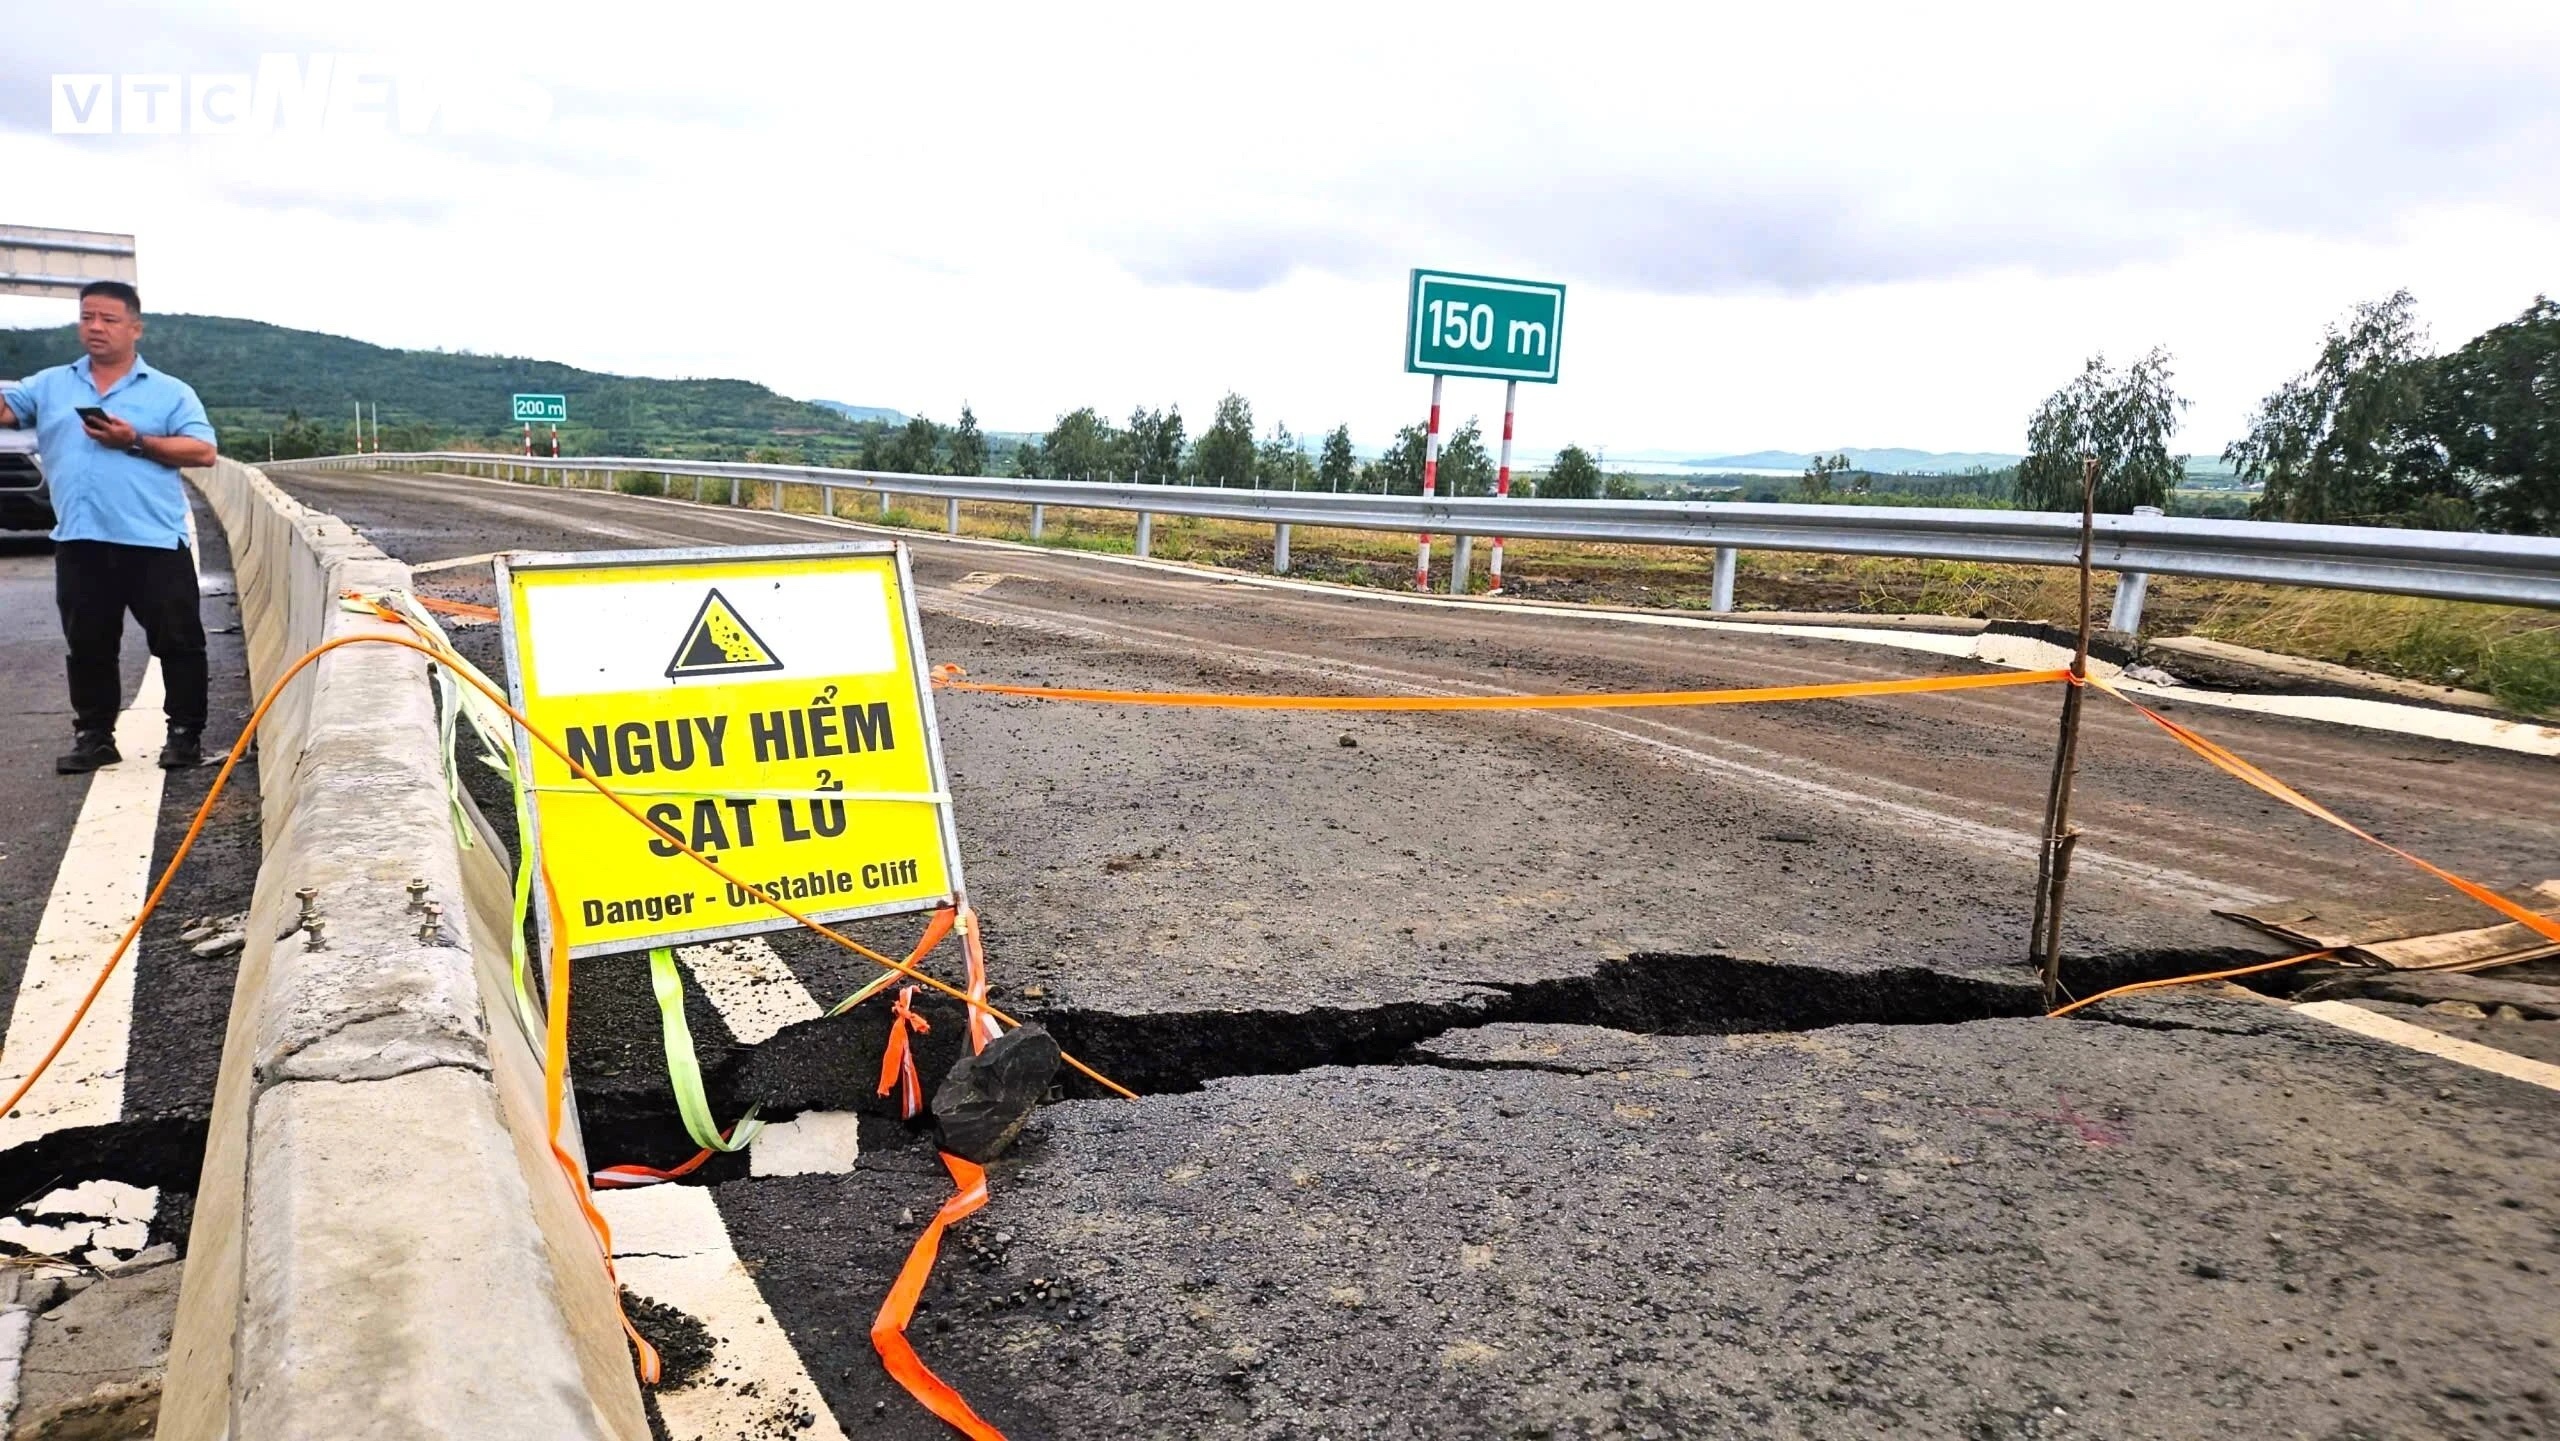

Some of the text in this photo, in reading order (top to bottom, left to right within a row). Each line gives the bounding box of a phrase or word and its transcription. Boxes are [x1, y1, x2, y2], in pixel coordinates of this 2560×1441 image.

[1429, 299, 1547, 356] 150 m
[517, 400, 563, 415] 200 m
[565, 685, 895, 779] NGUY HIỂM
[646, 797, 757, 864] SẠT
[583, 891, 695, 927] Danger
[726, 871, 853, 908] Unstable
[861, 859, 919, 889] Cliff
